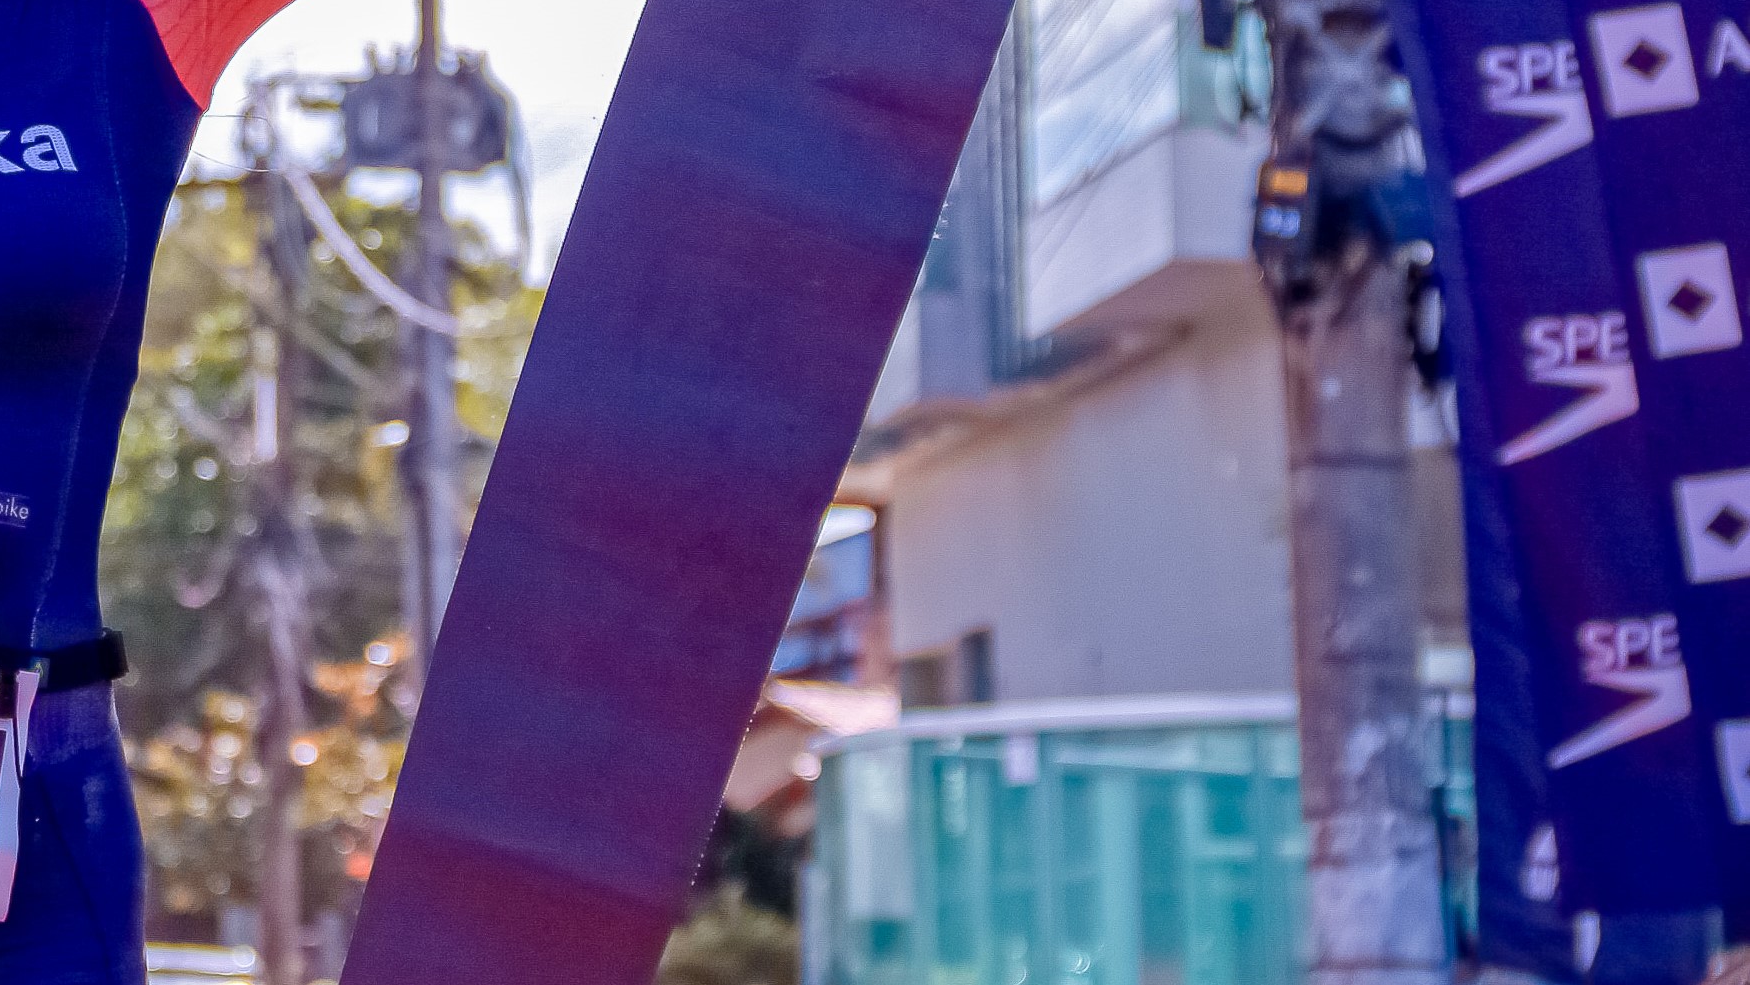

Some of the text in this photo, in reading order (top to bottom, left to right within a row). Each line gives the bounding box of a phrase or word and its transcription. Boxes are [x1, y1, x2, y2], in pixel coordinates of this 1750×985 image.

[1477, 40, 1582, 96] SPE
[1522, 312, 1630, 366] SPE
[1576, 613, 1681, 668] SPE
